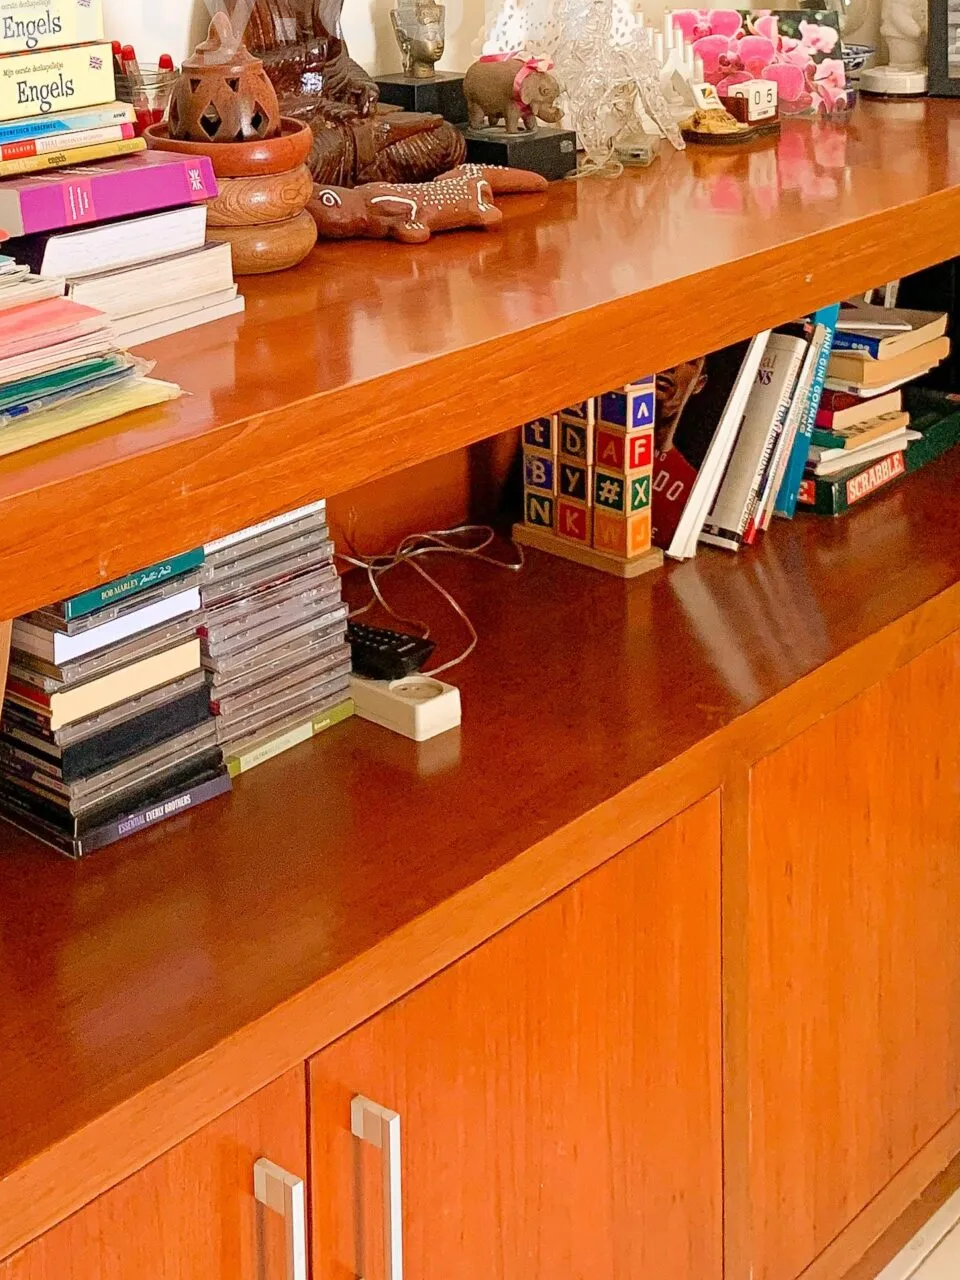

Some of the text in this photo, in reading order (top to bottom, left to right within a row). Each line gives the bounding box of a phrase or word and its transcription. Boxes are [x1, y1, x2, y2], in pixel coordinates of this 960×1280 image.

[2, 10, 62, 49] Engels
[16, 74, 75, 113] Engels
[804, 325, 834, 438] ANNE-GINE GOEMANS
[634, 439, 647, 465] F
[532, 459, 546, 483] B
[565, 469, 580, 493] Y
[849, 453, 901, 500] SCRABBLE
[633, 479, 648, 506] X
[530, 497, 550, 523] N
[565, 508, 580, 533] K
[101, 579, 138, 600] BOB MARLEY
[118, 814, 146, 835] ESSENTIAL
[164, 794, 191, 813] BROTHERS
